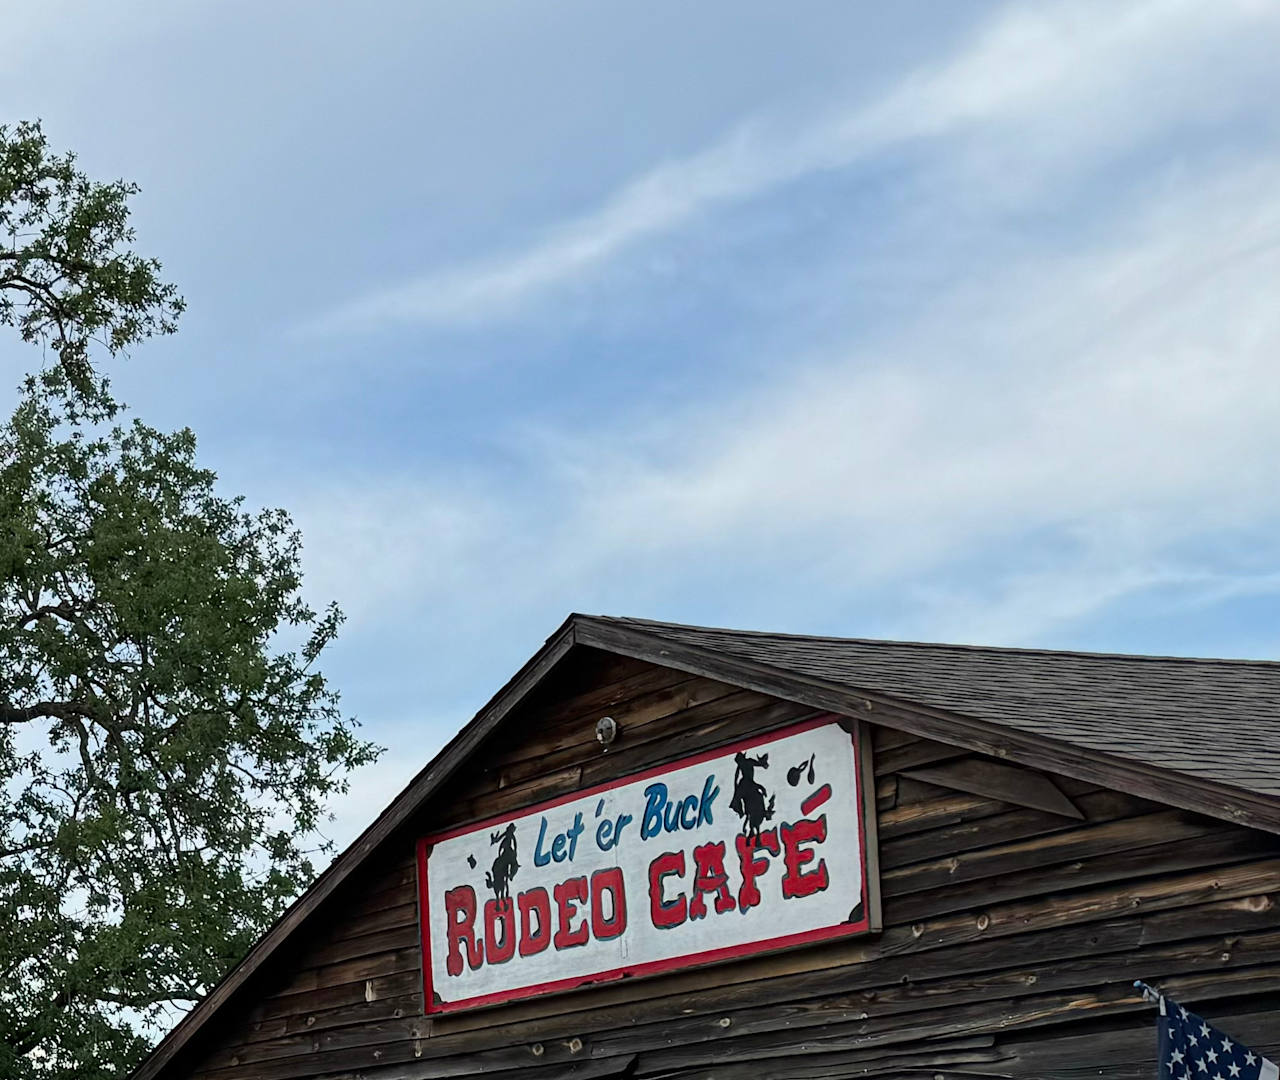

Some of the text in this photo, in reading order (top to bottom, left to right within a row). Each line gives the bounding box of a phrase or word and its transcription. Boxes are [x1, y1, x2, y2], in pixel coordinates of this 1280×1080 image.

[445, 784, 833, 976] RODEO CAFÉ
[533, 774, 721, 867] Let 'er Buck
